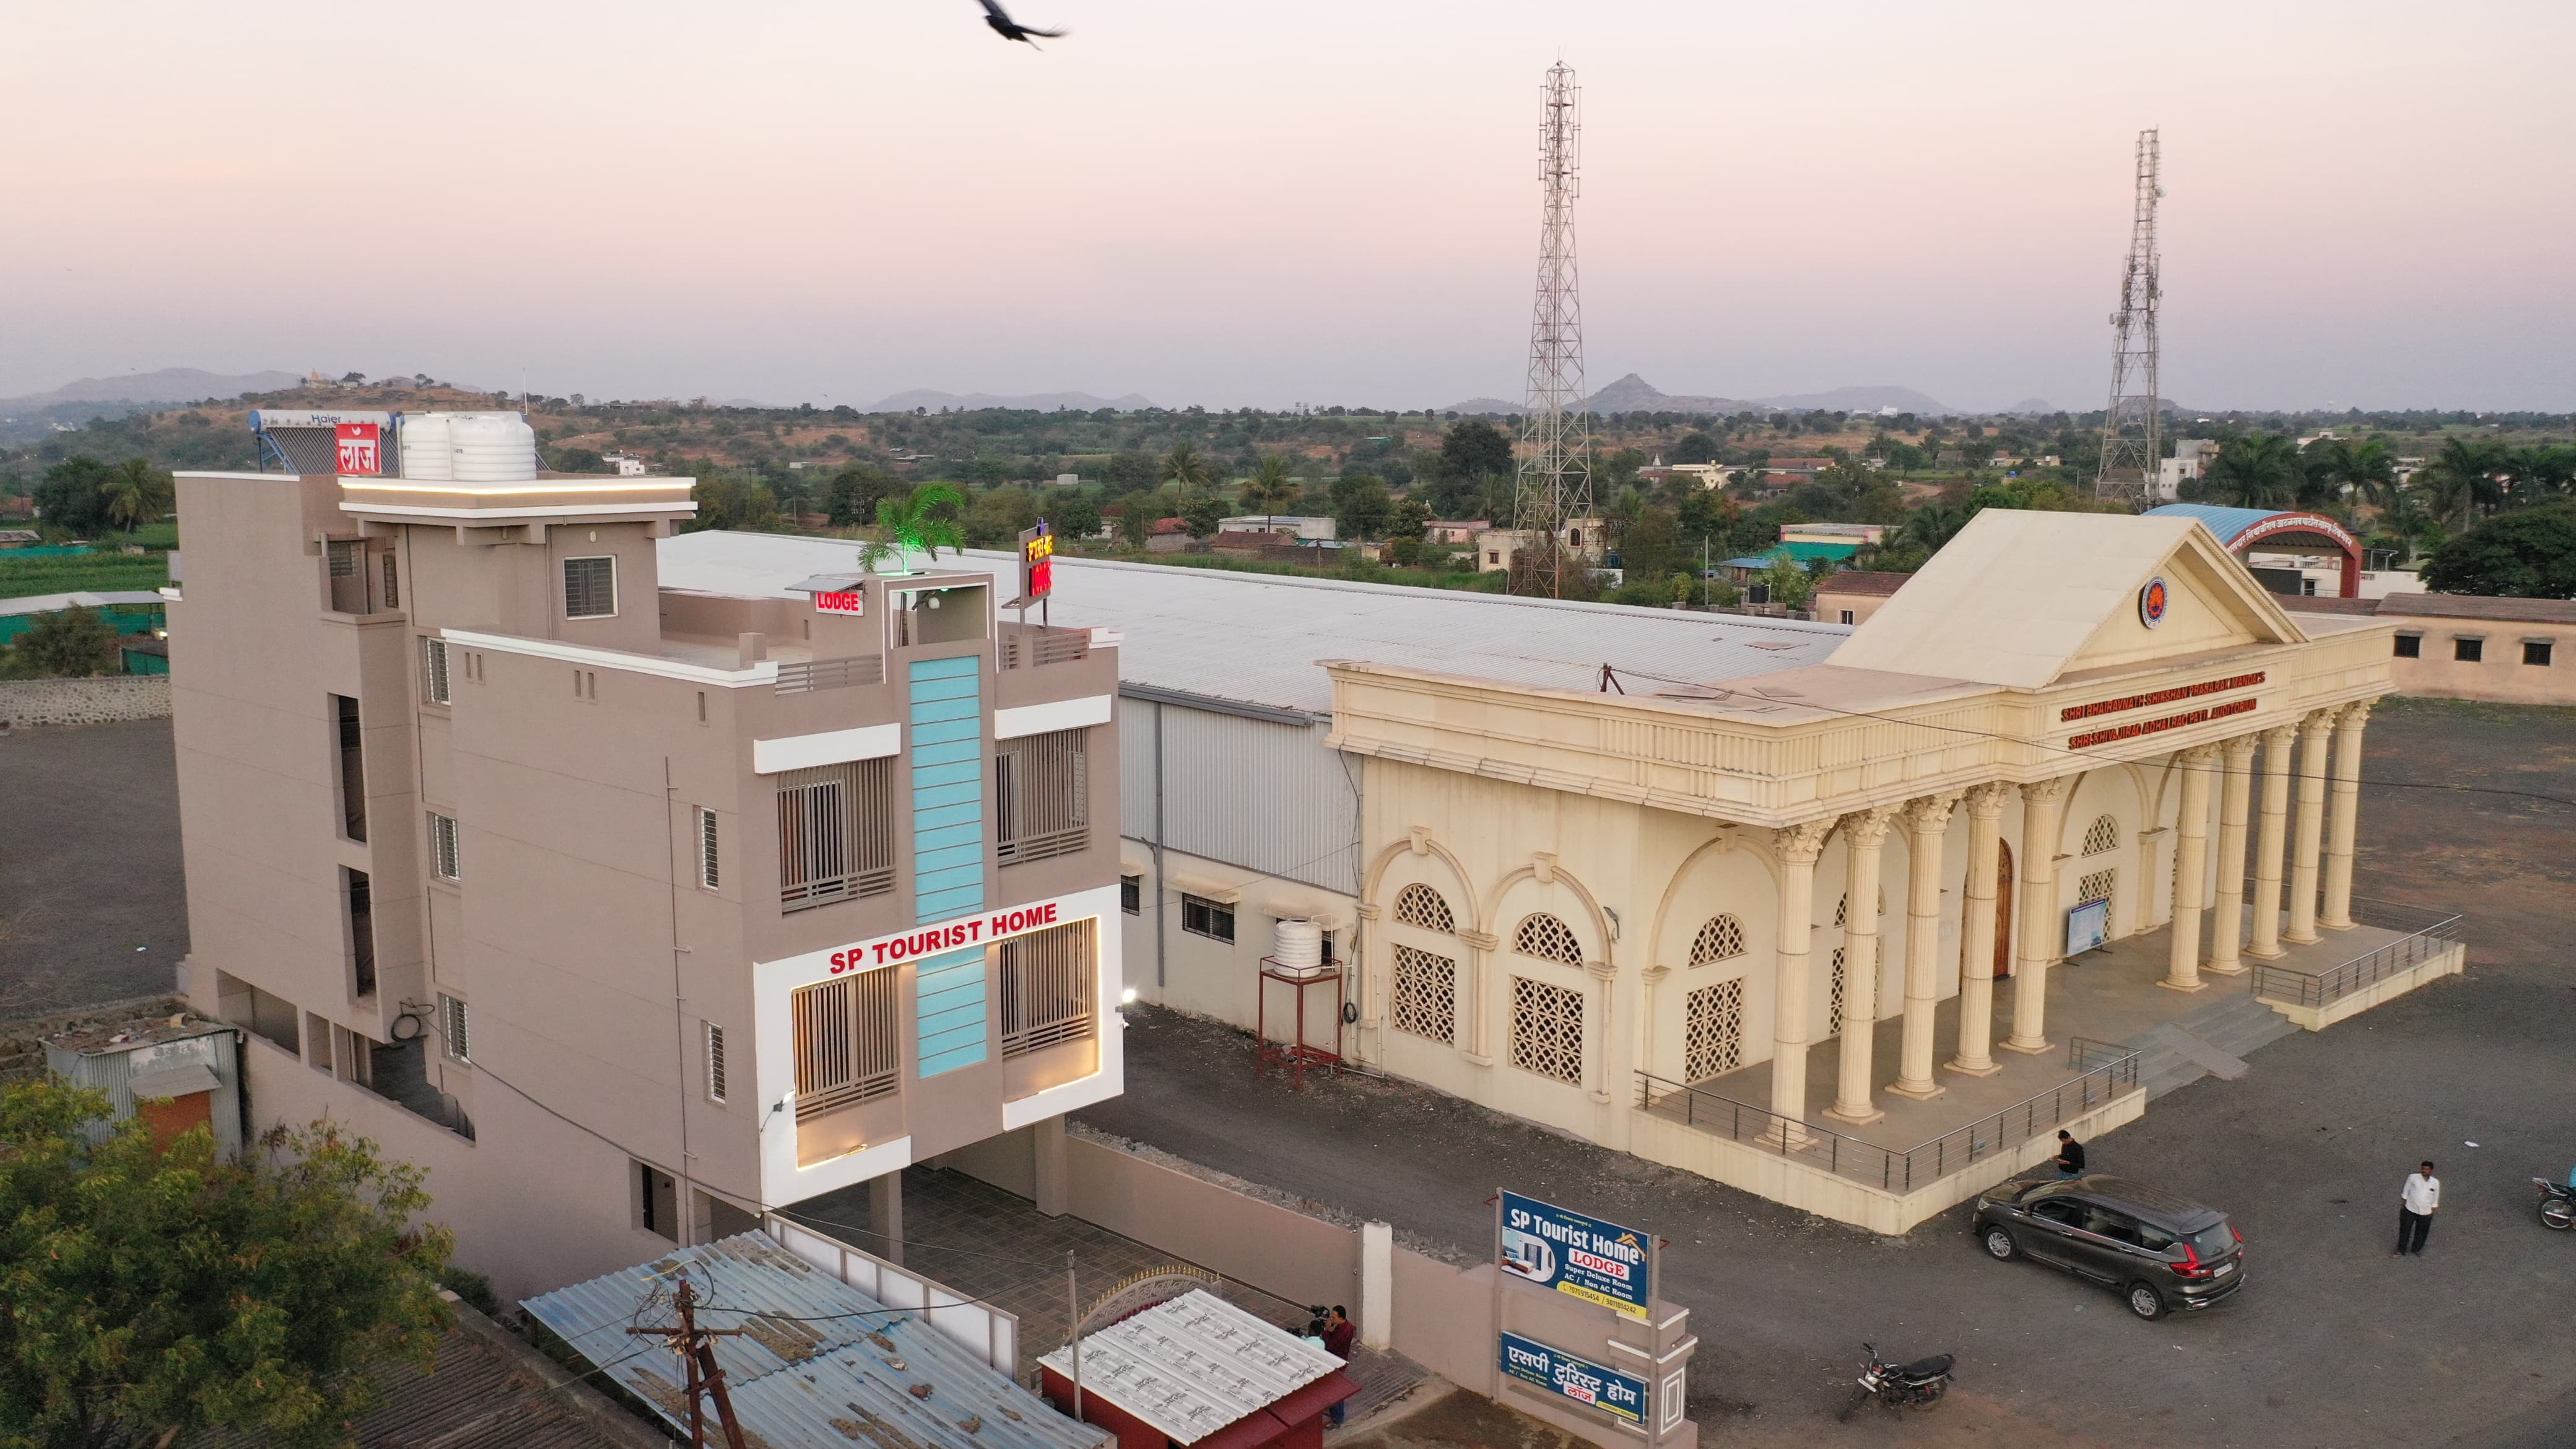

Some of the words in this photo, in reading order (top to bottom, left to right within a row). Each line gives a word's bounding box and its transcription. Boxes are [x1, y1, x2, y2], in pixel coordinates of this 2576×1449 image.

[311, 414, 341, 424] Haier
[339, 426, 375, 472] लॉज
[818, 592, 859, 612] LODGE
[2061, 705, 2085, 722] SHRI
[2144, 686, 2188, 705] SHIKSHAN
[2068, 733, 2091, 750] SHRI
[830, 947, 863, 974] SP
[872, 920, 983, 964] TOURIST
[992, 902, 1058, 936] HOME
[1510, 1208, 1530, 1229] SP
[1533, 1215, 1589, 1250] Tourist
[1593, 1234, 1639, 1265] Home
[1564, 1263, 1585, 1276] Super
[1586, 1269, 1610, 1283] Deluxe
[1612, 1278, 1633, 1290] Room
[1573, 1251, 1625, 1277] LODGE
[1564, 1273, 1575, 1281] AC
[1585, 1279, 1598, 1289] Non
[1599, 1284, 1610, 1292] AC
[1612, 1287, 1633, 1300] Room
[1508, 1346, 1549, 1373] एसपी
[1552, 1363, 1602, 1391] टुरिस्ट
[1606, 1380, 1637, 1405] होम
[1567, 1386, 1592, 1402] लॉज
